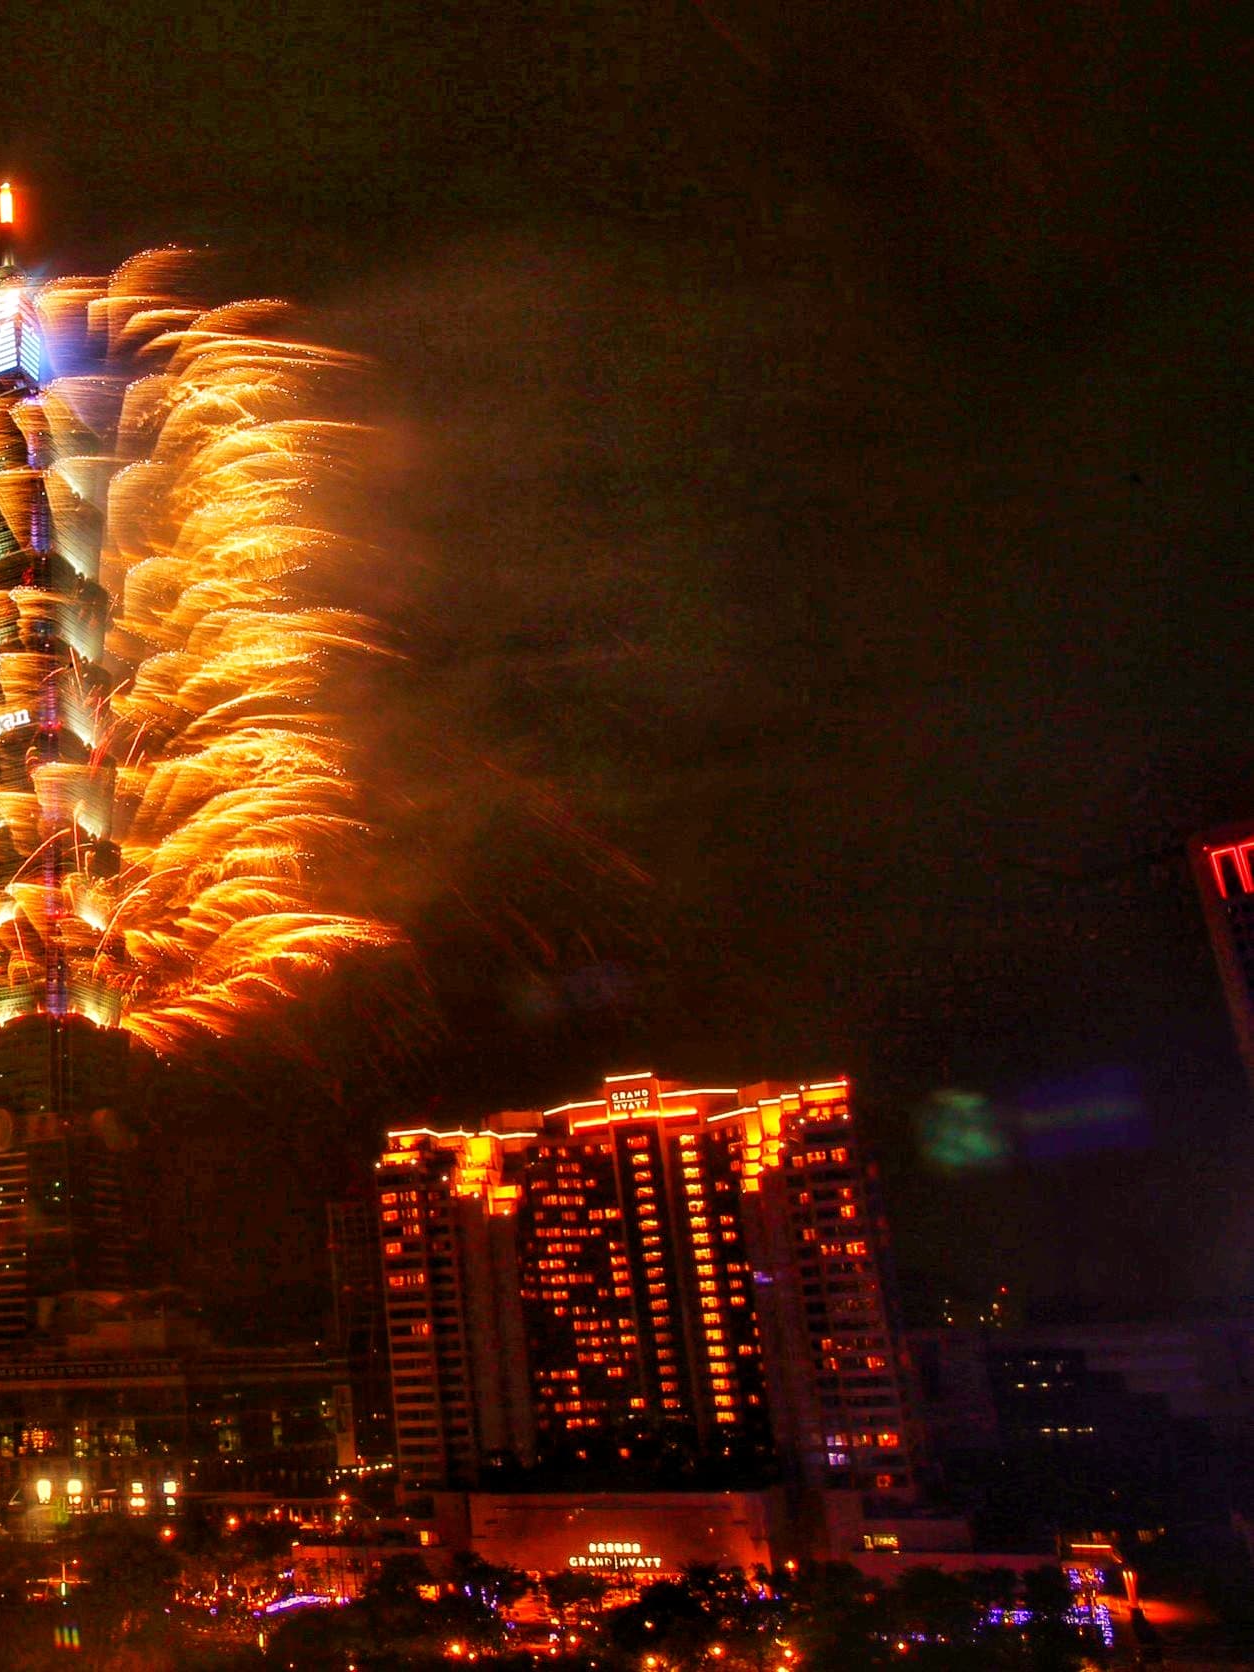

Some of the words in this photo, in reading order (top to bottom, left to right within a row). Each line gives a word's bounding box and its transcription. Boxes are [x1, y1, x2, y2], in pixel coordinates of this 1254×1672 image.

[611, 1089, 649, 1101] GRAND
[613, 1100, 649, 1111] HYATT
[569, 1556, 612, 1567] GRAND
[619, 1557, 661, 1568] HYATT
